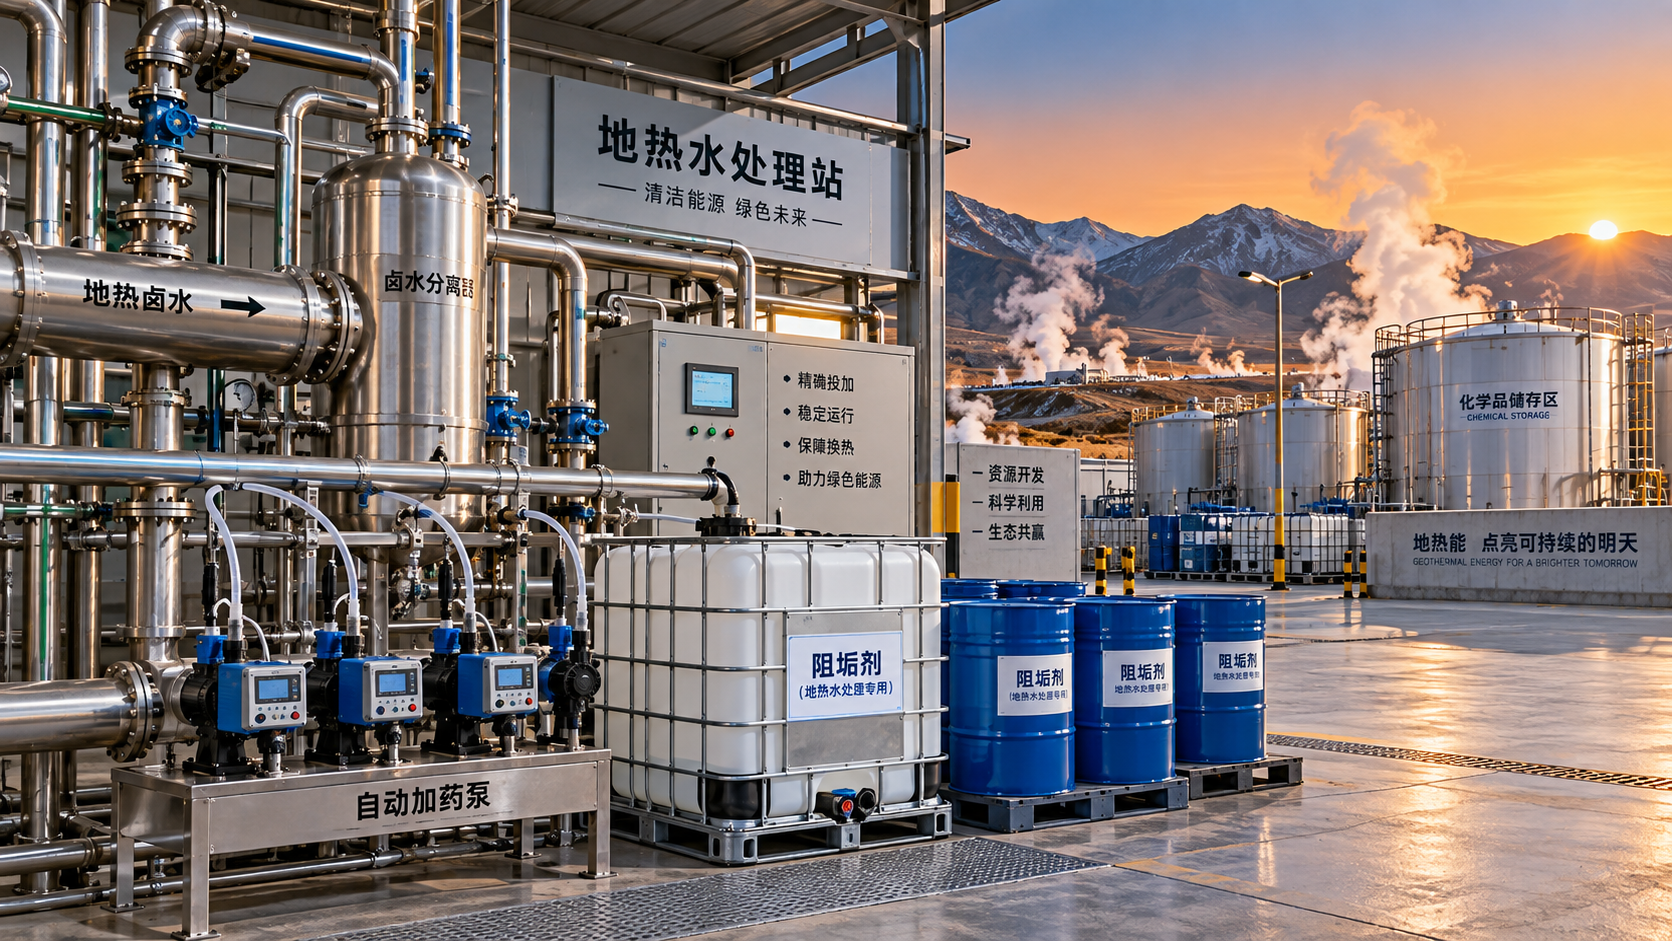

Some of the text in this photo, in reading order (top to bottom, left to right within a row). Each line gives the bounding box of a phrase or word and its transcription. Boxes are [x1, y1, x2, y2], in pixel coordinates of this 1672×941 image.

[598, 114, 843, 200] 地热水处理站
[645, 182, 807, 227] 清洁能源 绿色未来
[83, 278, 194, 315] 地热卤水
[798, 404, 854, 424] 稳定运行
[1467, 412, 1550, 421] CHEMICAL STORAGE
[798, 470, 882, 490] 助力绿色能源
[989, 464, 1044, 484] 资源开发
[988, 494, 1044, 511] 科学利用
[988, 523, 1045, 540] 生态共赢
[1413, 532, 1638, 554] 地热能 点亮可持续的明天
[1470, 558, 1503, 566] ENERGY
[1506, 558, 1524, 566] FOR
[1526, 558, 1533, 566] A
[1536, 558, 1580, 567] BRIGHTER
[1583, 558, 1638, 568] TOMORROW
[812, 650, 881, 679] 阻垢剂
[1219, 652, 1257, 668] 阻垢剂
[1016, 668, 1064, 688] 阻垢剂
[1120, 662, 1165, 681] 阻垢剂
[358, 780, 490, 821] 自动加药泵
